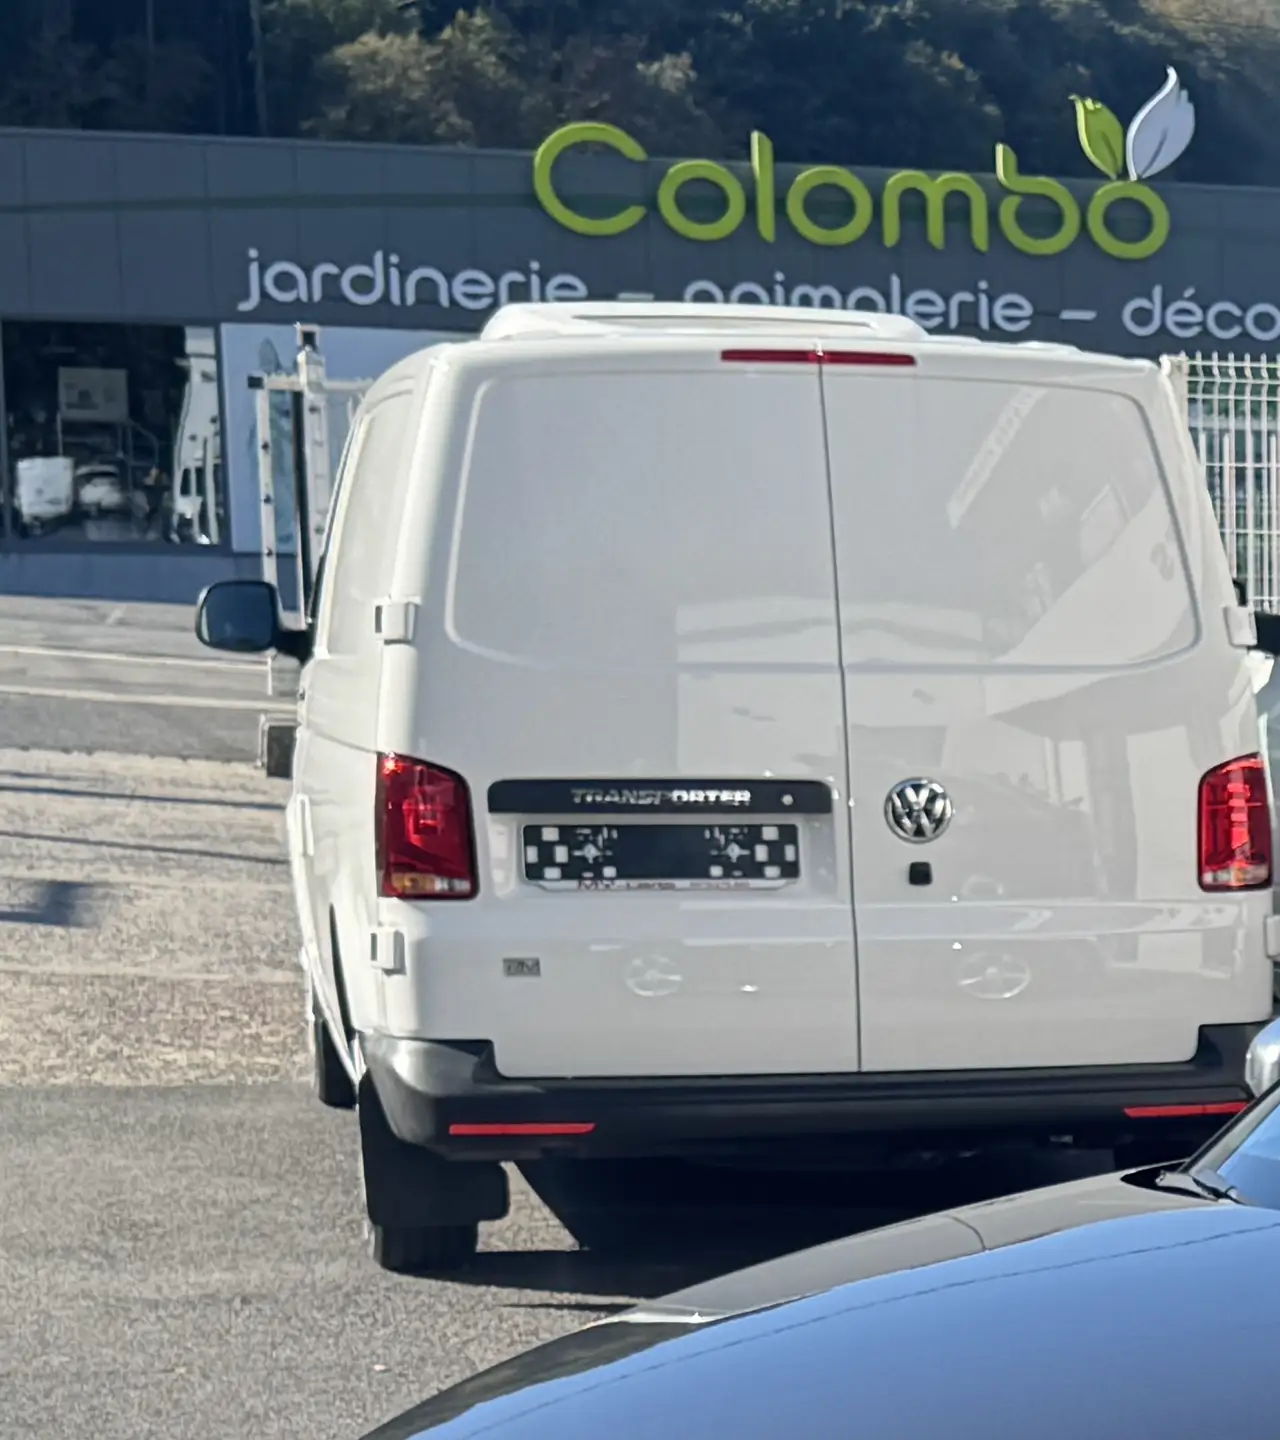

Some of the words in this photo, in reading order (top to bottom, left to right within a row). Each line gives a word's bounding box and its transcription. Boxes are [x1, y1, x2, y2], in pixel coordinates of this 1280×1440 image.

[534, 121, 1170, 260] Colombo
[237, 247, 589, 312] jardinerie
[571, 788, 752, 805] TRANSPORTER
